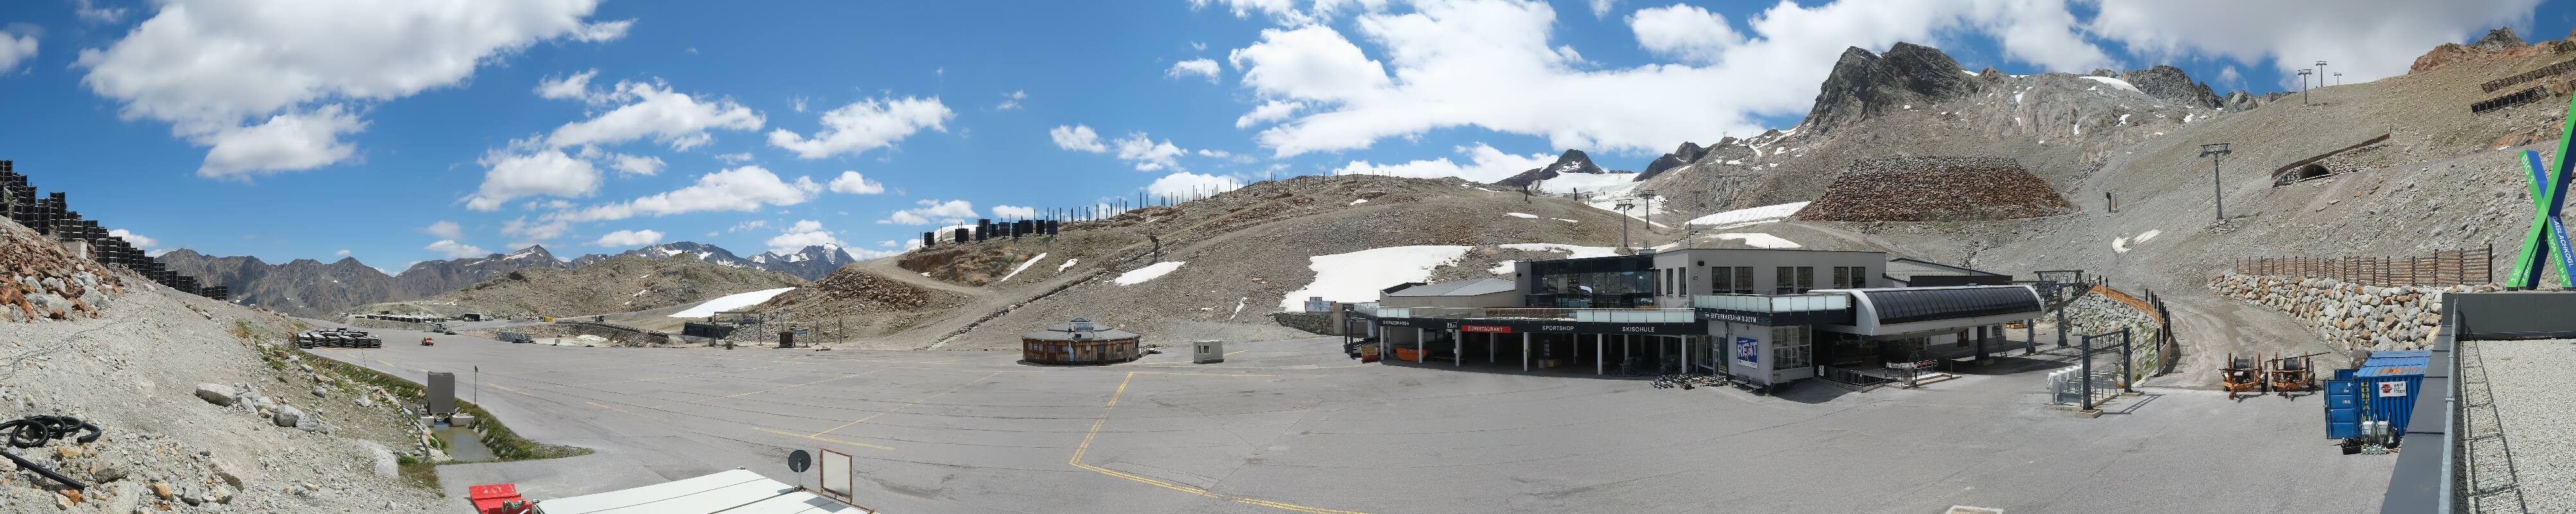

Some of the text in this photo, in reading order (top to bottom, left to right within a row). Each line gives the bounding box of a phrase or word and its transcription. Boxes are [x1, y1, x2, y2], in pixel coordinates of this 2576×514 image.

[2521, 154, 2534, 184] BIG 3
[2552, 216, 2574, 267] GAISLACHKOGL
